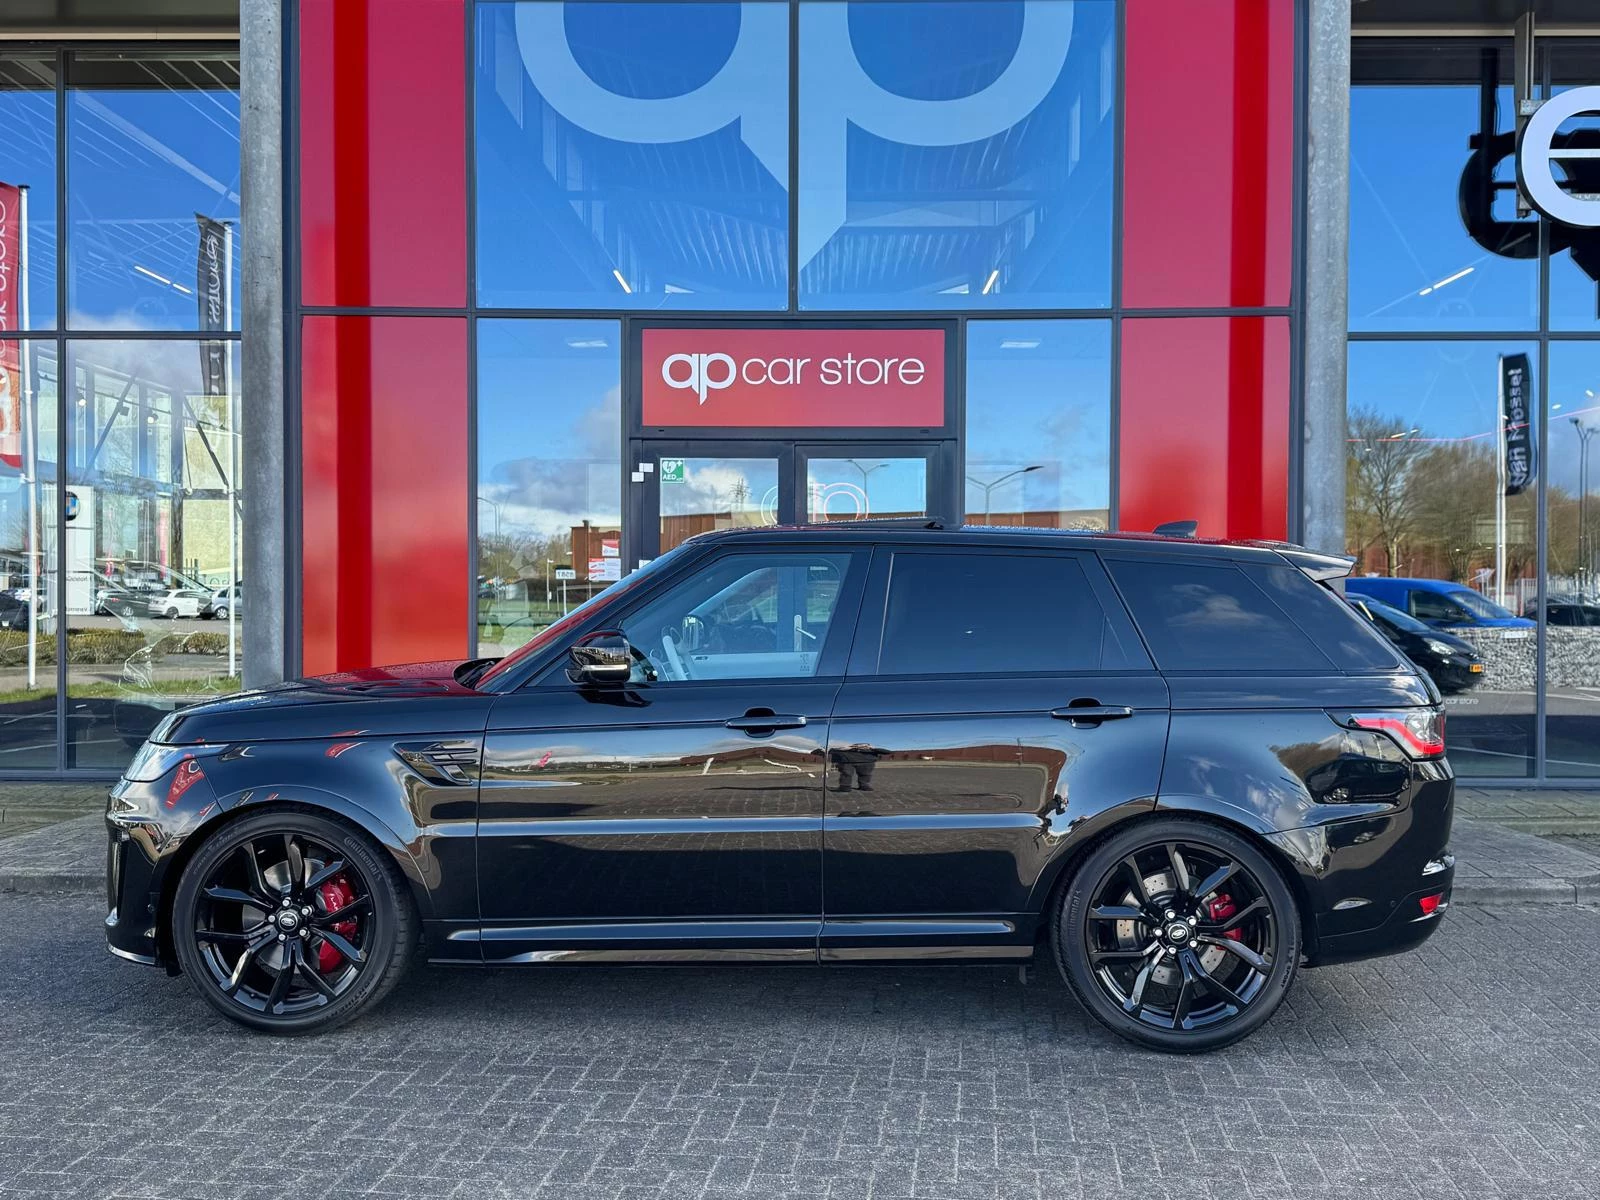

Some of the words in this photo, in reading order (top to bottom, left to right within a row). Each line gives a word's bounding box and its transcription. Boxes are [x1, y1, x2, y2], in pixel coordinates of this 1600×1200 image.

[662, 353, 737, 406] ap
[742, 358, 811, 385] car
[820, 353, 925, 385] store
[662, 473, 677, 481] AED
[343, 836, 381, 877] Continental
